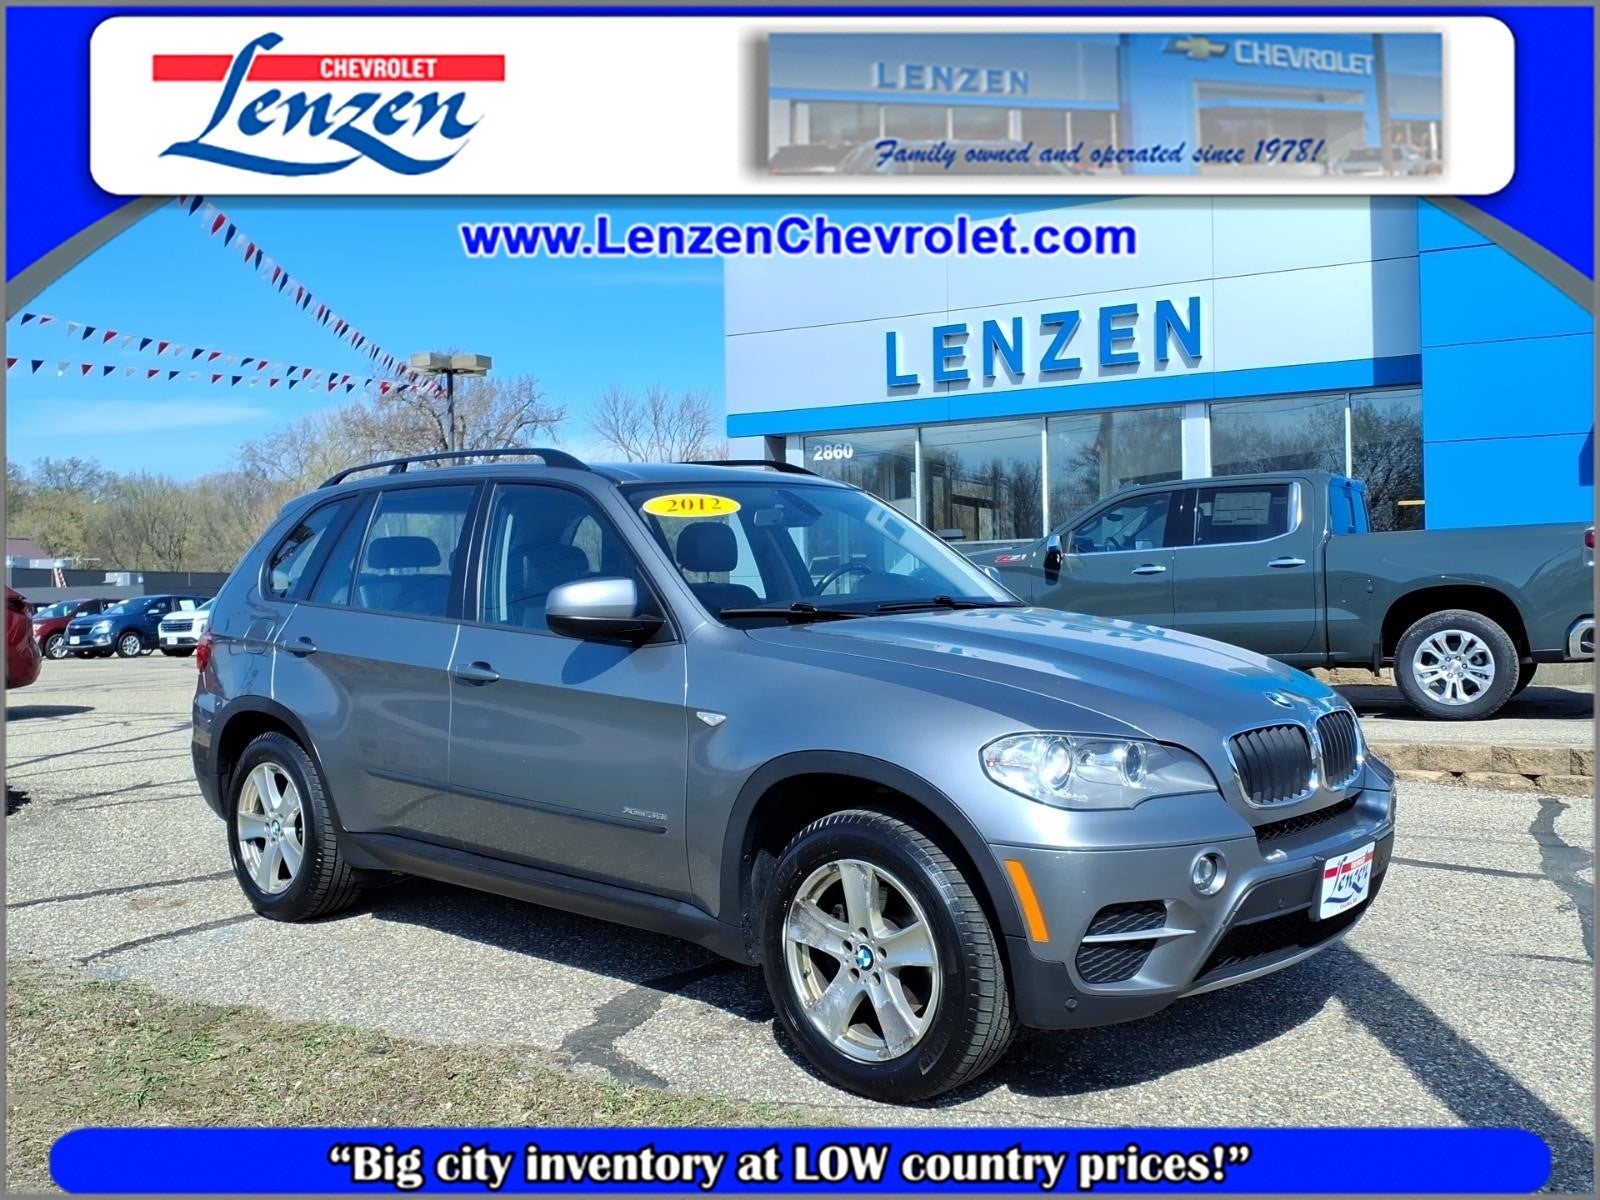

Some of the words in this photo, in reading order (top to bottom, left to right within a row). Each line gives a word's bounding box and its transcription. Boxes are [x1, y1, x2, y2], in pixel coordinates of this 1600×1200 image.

[886, 296, 1203, 388] LENZEN
[813, 443, 854, 461] 2860
[666, 498, 722, 513] 2012
